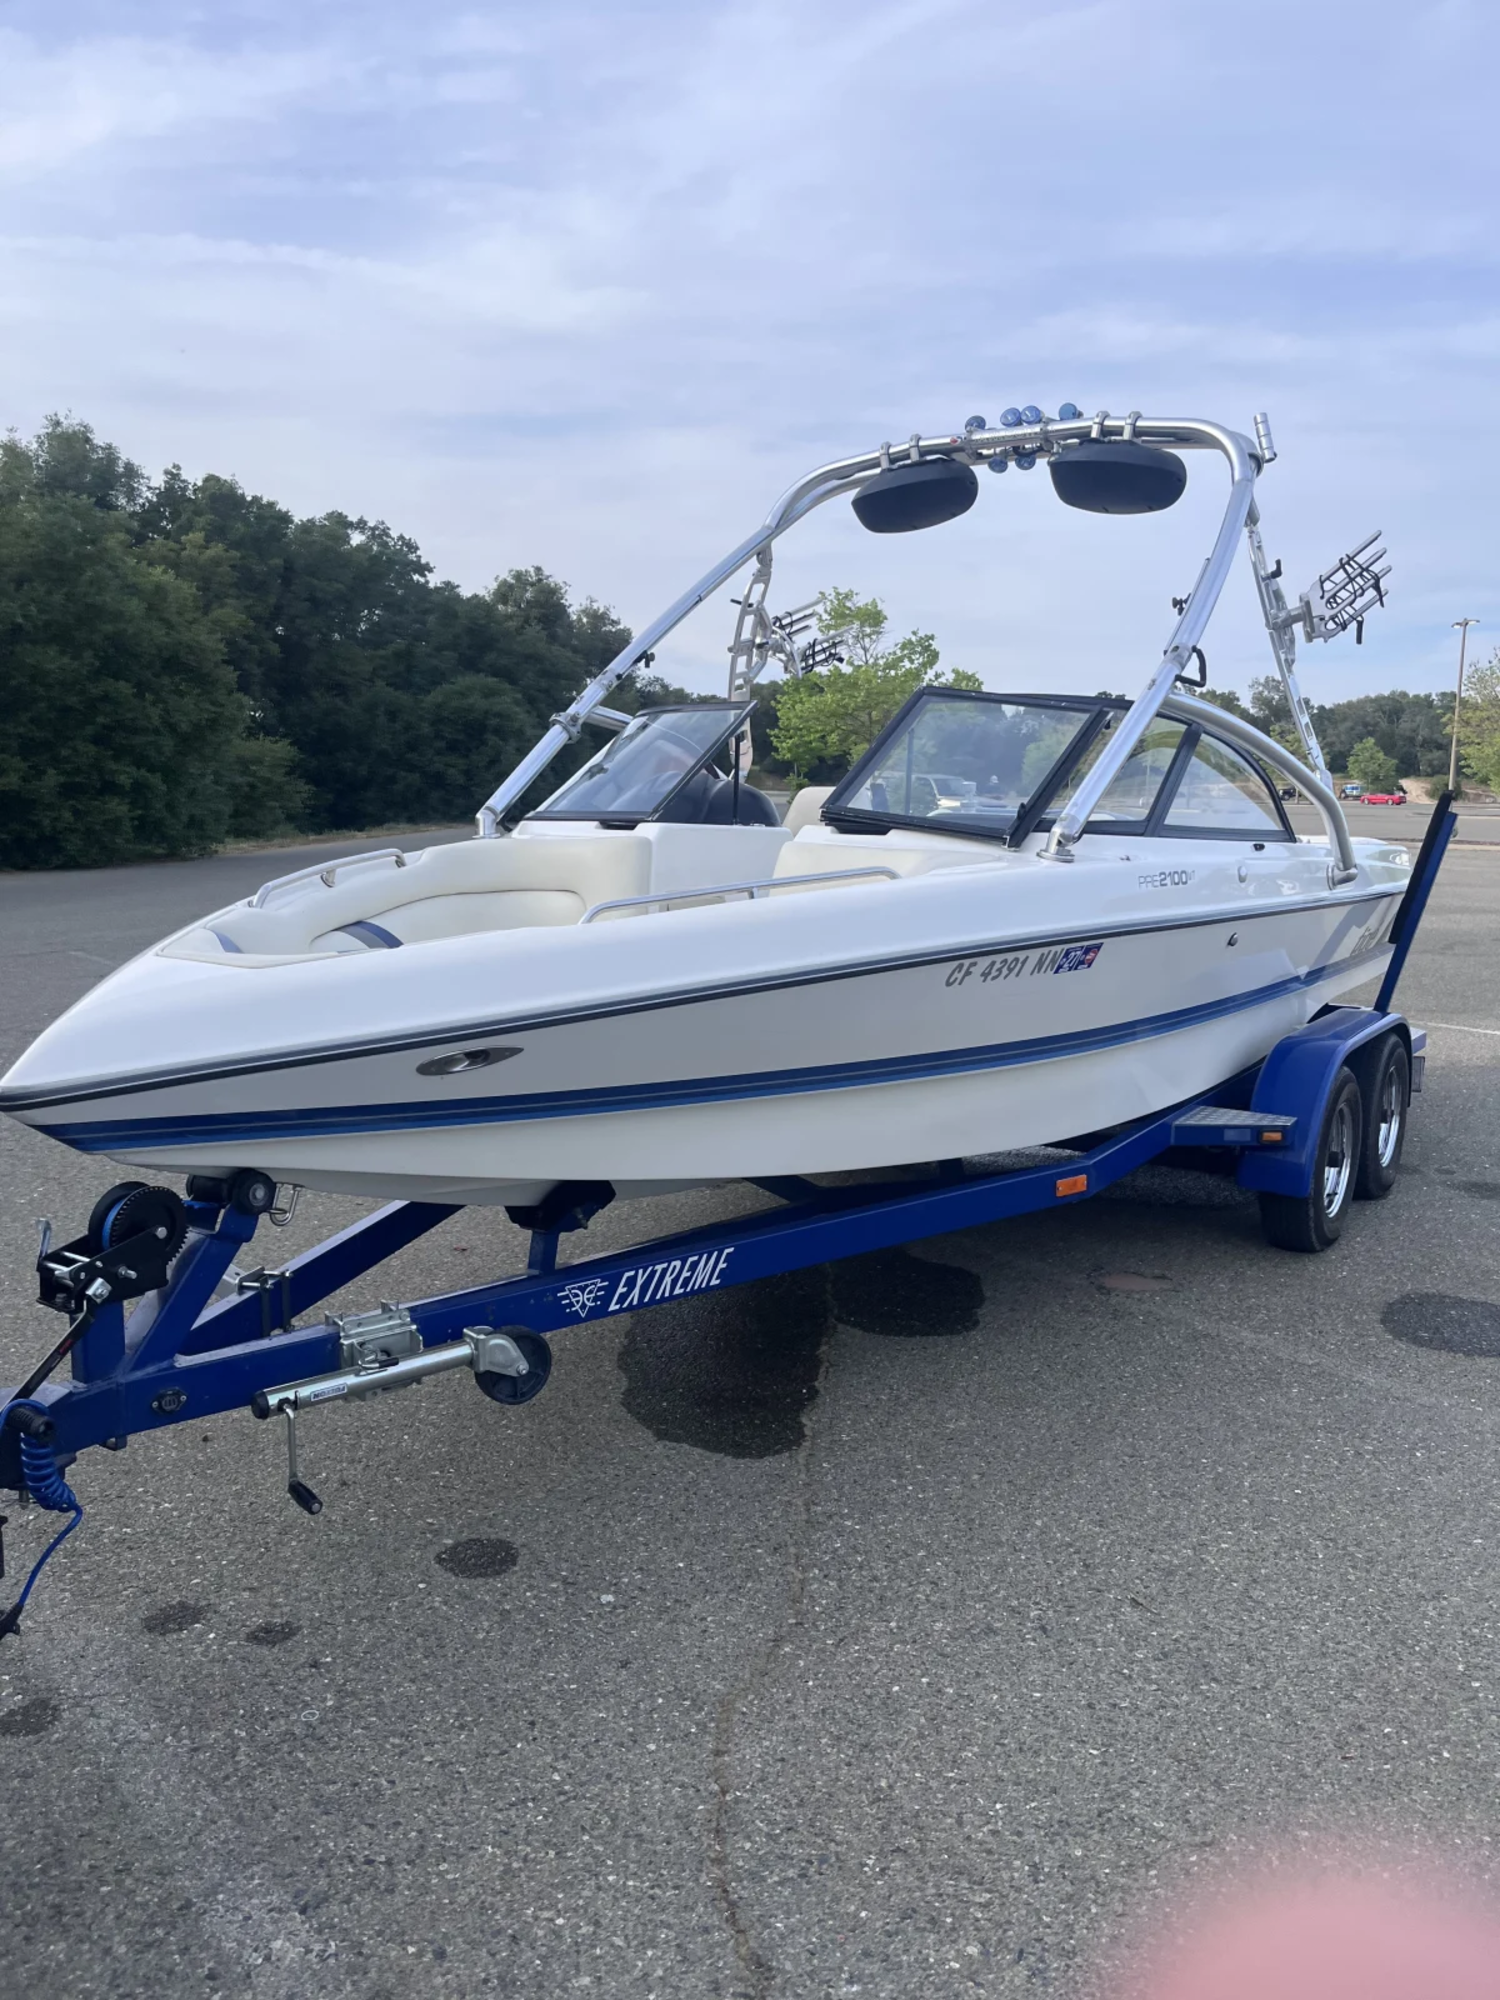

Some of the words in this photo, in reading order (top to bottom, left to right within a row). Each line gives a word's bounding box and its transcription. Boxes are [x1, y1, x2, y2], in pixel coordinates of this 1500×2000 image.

[945, 961, 978, 987] CF
[980, 955, 1029, 983] 4391
[1030, 948, 1064, 976] NN
[608, 1247, 735, 1312] EXTREME
